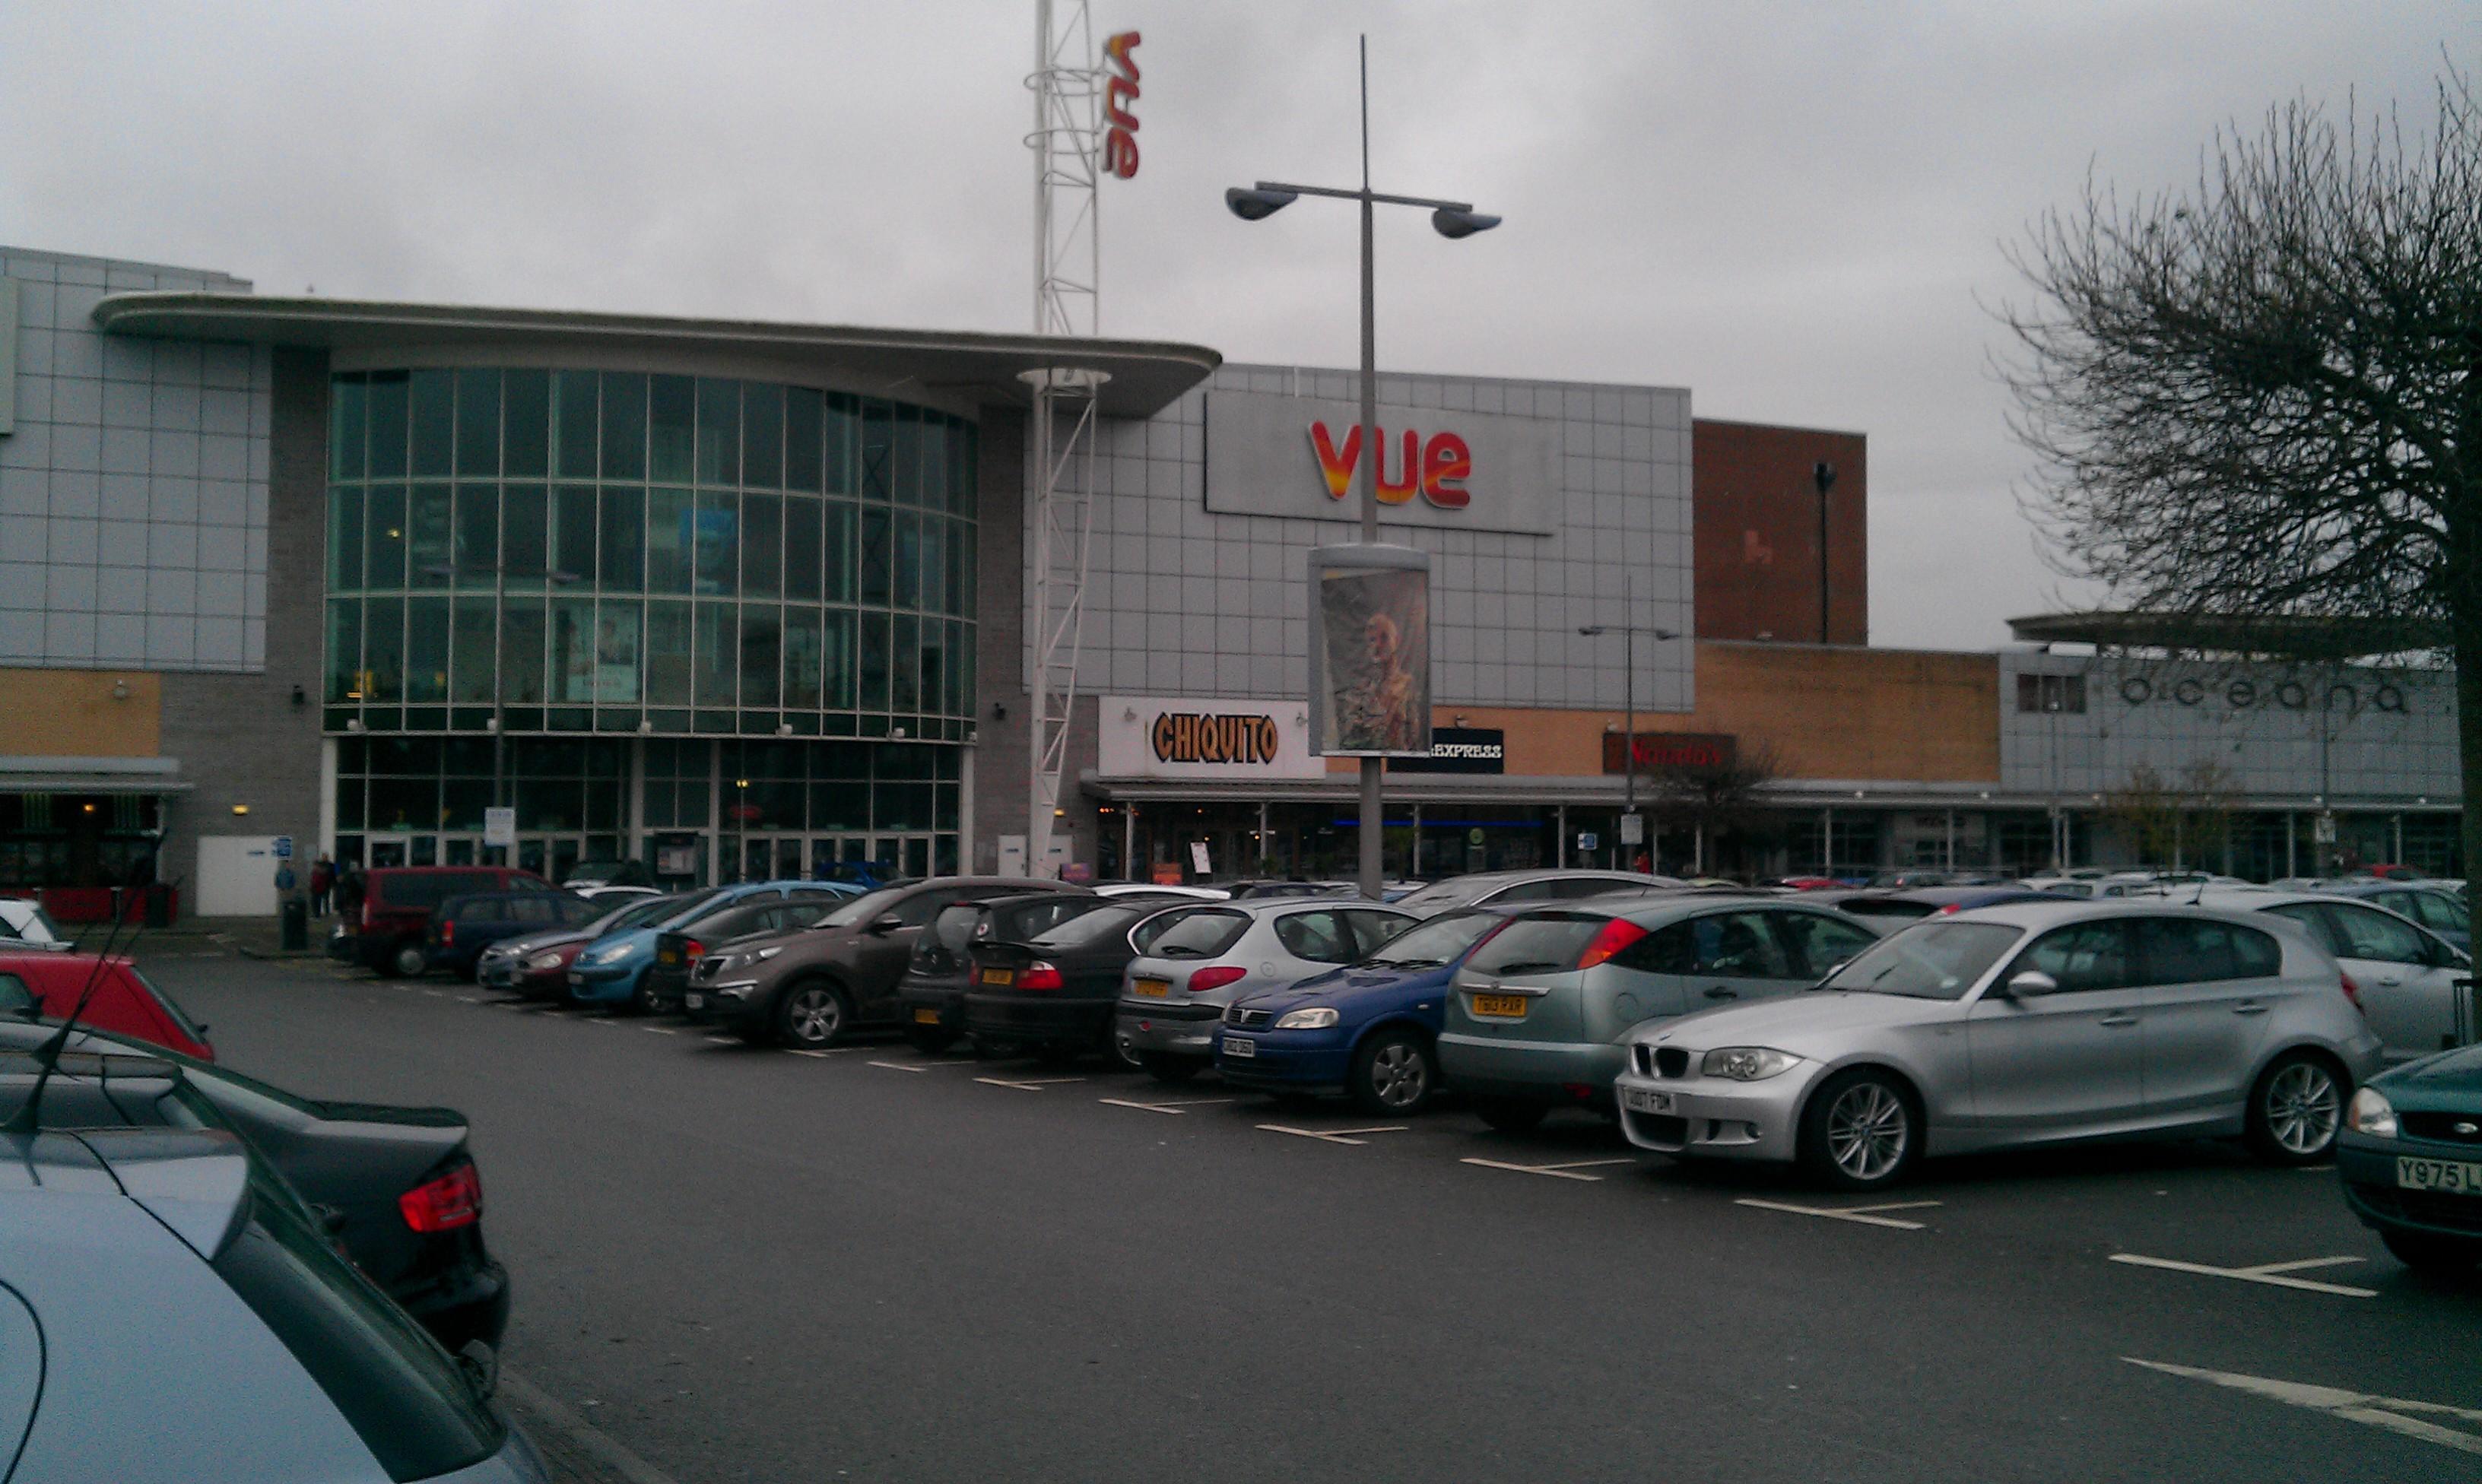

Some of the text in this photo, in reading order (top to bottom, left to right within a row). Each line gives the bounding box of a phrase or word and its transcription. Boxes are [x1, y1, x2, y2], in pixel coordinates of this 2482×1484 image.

[1105, 31, 1141, 179] vue
[1309, 420, 1471, 509] vue
[2120, 677, 2410, 715] oceana
[1153, 712, 1278, 765] CHIQUITO
[2400, 1159, 2482, 1191] Y975 L
